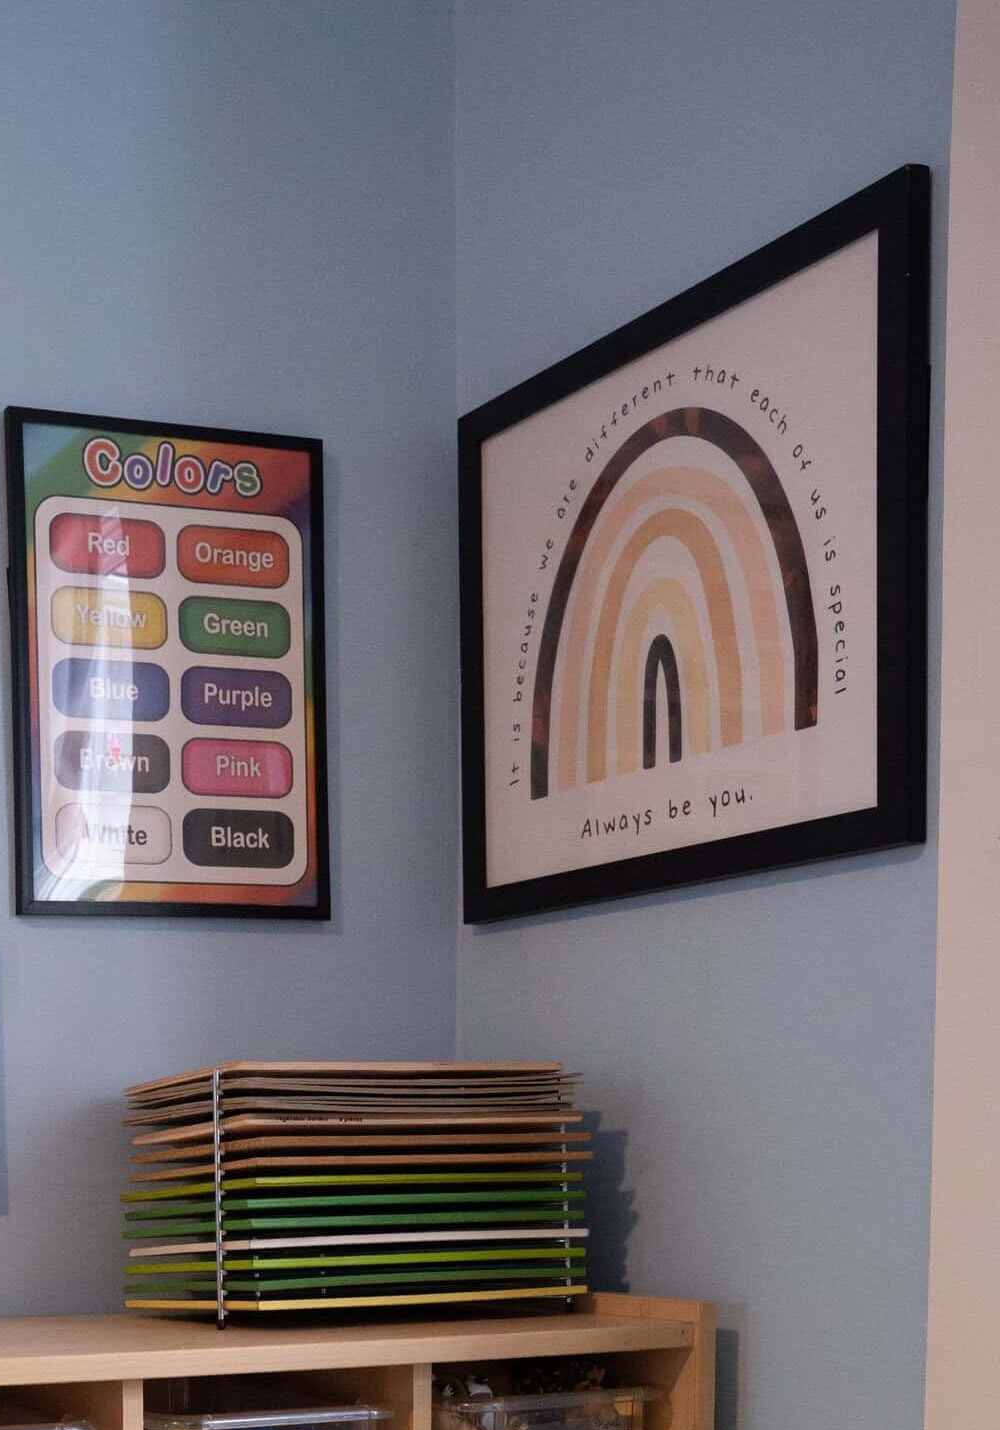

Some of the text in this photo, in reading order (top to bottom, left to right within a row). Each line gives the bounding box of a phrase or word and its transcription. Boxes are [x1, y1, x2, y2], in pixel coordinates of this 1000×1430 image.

[81, 438, 264, 498] Colors
[87, 532, 130, 557] Red
[195, 541, 275, 570] Orange
[509, 366, 849, 787] It is because we are different that each of us is special
[75, 603, 147, 629] Yellow
[202, 613, 269, 639] Green
[89, 677, 139, 701] Blue
[203, 683, 273, 710] Purple
[216, 755, 262, 778] Pink
[580, 787, 753, 839] Always be you.
[210, 827, 270, 850] Black
